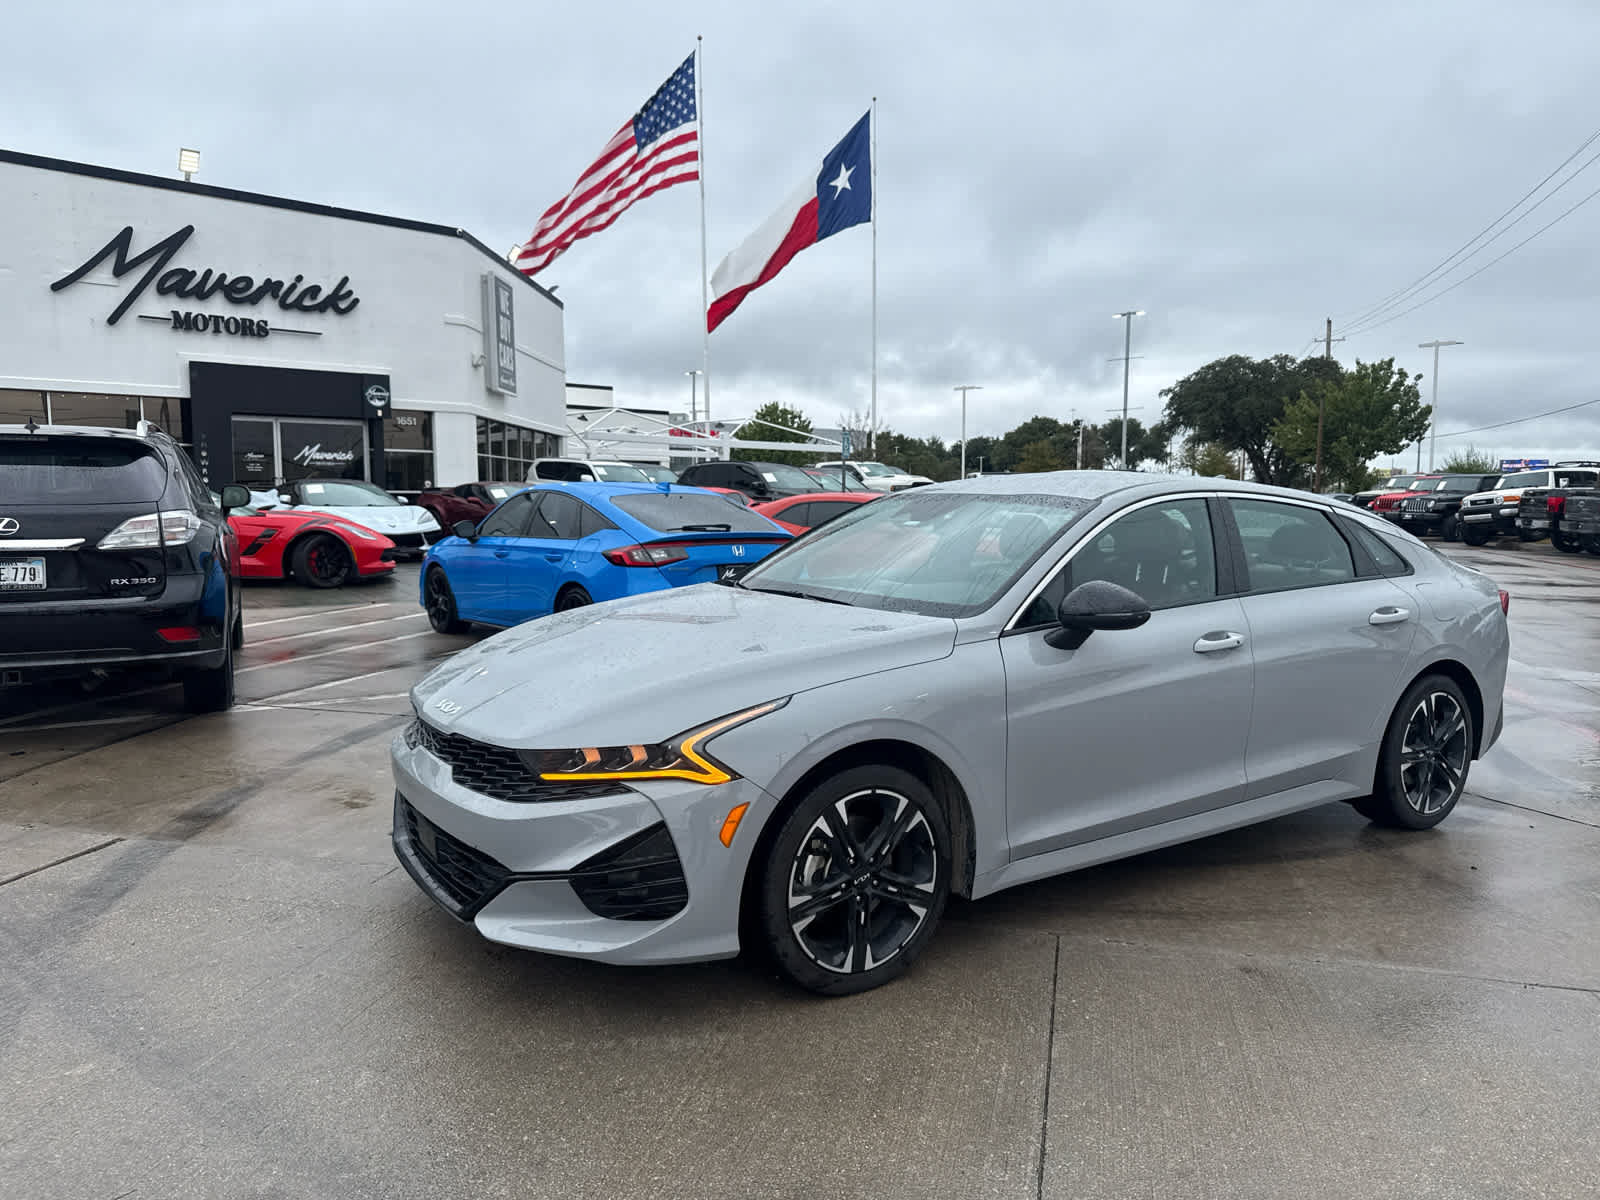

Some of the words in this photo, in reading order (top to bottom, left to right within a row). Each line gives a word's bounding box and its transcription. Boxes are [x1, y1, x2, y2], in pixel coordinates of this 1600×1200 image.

[50, 224, 360, 326] Maverick
[171, 310, 270, 338] MOTORS
[395, 416, 417, 426] 1651
[293, 442, 354, 467] Maverick
